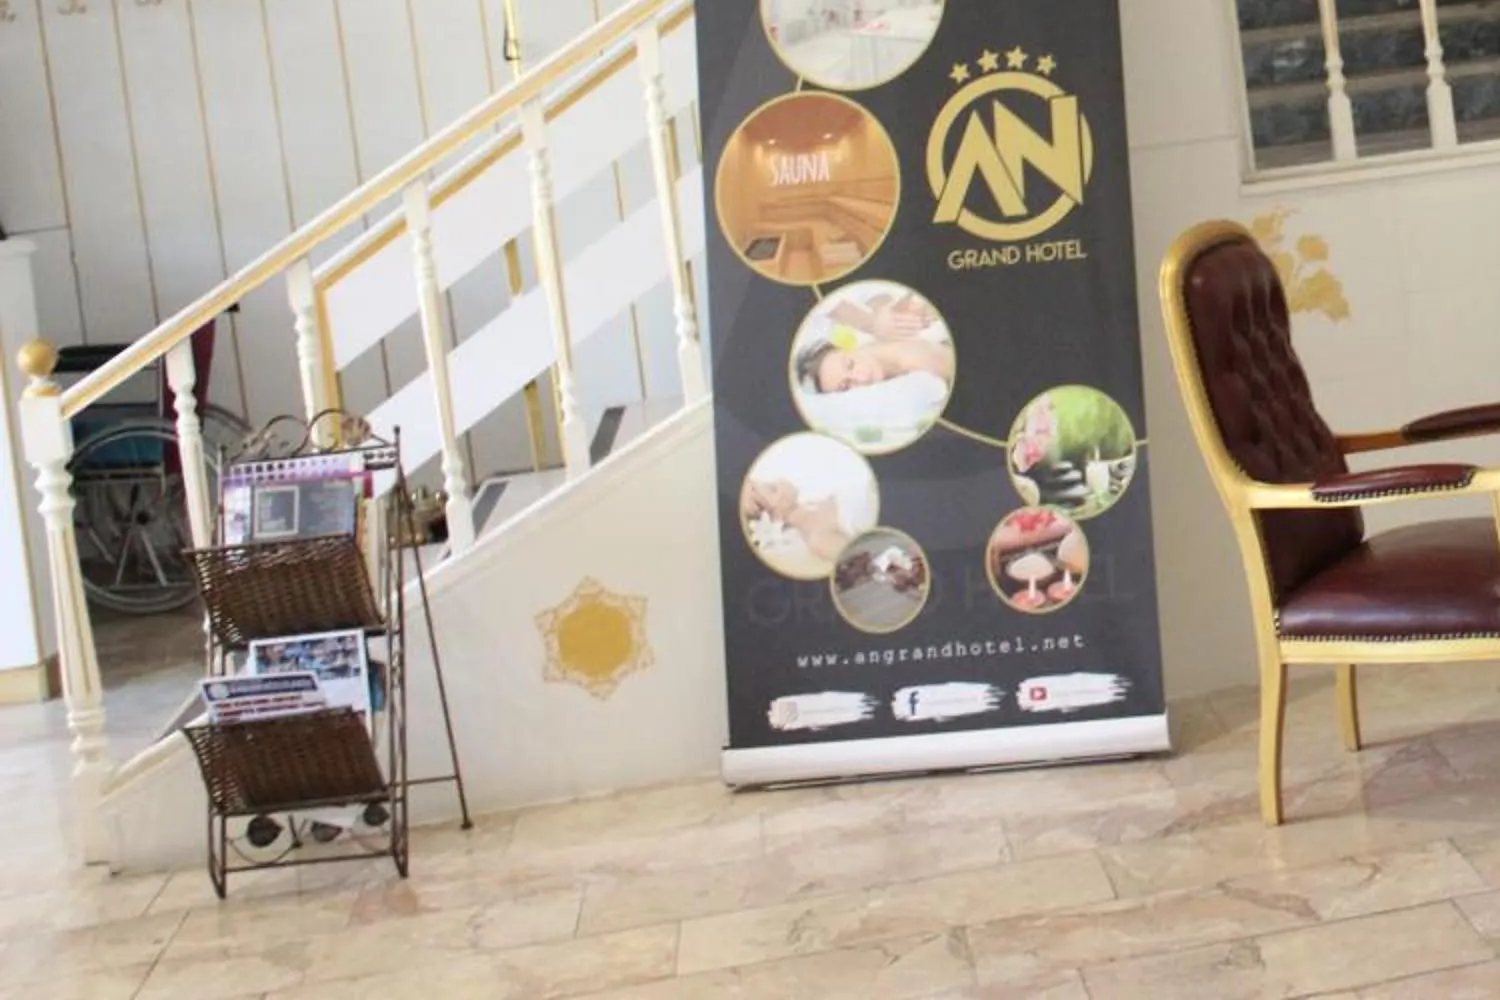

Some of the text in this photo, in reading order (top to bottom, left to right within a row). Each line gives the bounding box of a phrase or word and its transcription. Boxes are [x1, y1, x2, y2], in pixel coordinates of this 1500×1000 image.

[768, 153, 831, 186] SAUNA
[947, 239, 1088, 271] GRAND HOTEL
[796, 633, 1086, 669] www.angrandhotel.net
